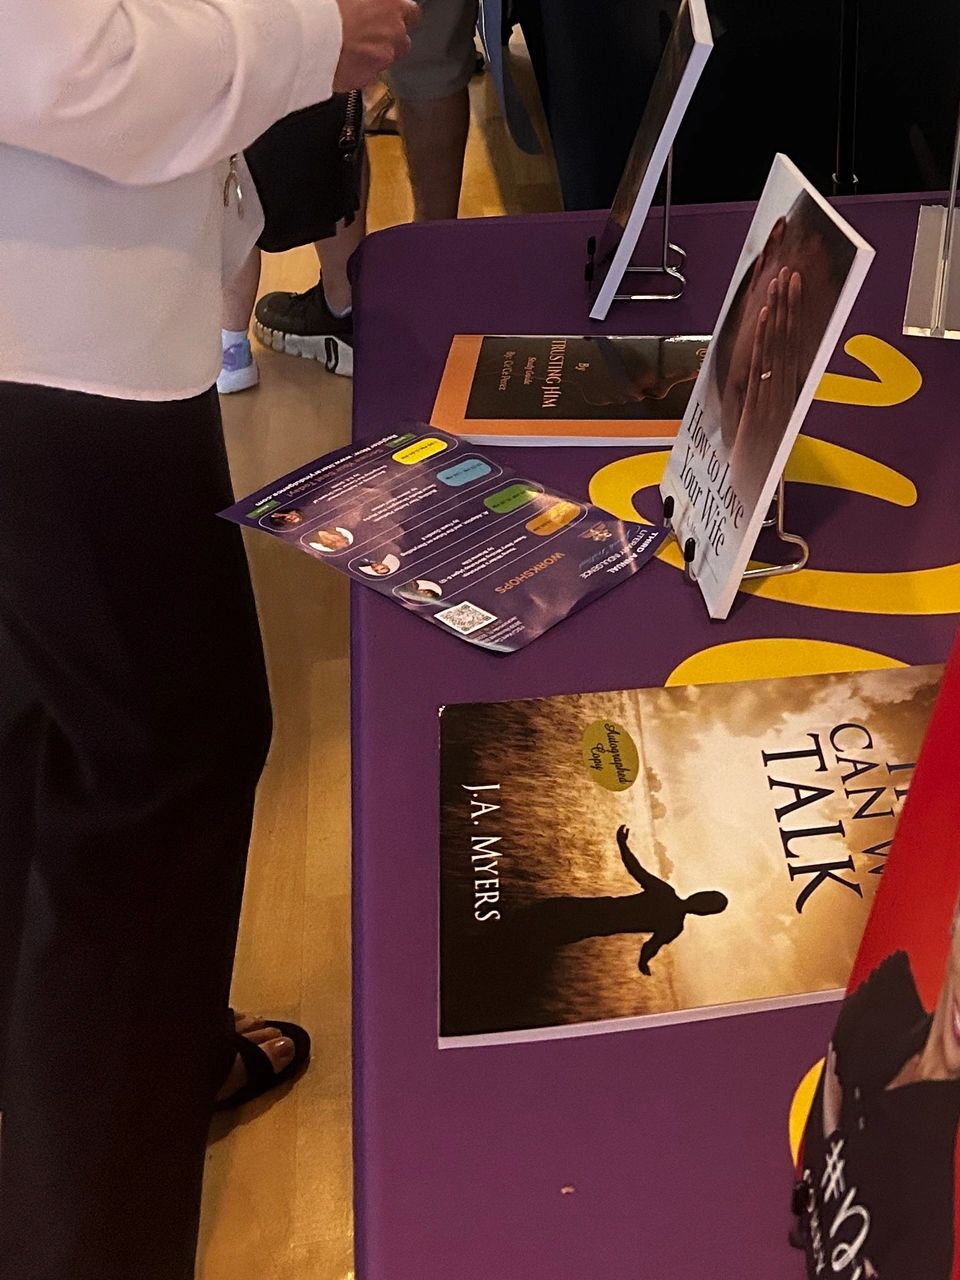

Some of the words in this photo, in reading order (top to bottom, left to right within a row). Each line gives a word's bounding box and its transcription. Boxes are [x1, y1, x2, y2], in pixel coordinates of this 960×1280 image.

[545, 339, 567, 384] TRUSTING
[541, 386, 562, 408] HIM
[687, 402, 712, 461] How
[707, 449, 721, 483] to
[716, 461, 745, 529] Love
[680, 444, 703, 507] Your
[700, 487, 727, 557] Wife
[636, 531, 659, 553] THIRD
[494, 549, 566, 596] WORKSHOPS
[588, 742, 606, 772] Copy
[604, 723, 632, 785] Autographed
[828, 722, 896, 820] CAN
[461, 783, 501, 827] J.A.
[760, 733, 863, 914] TALK
[470, 834, 501, 922] MYERS
